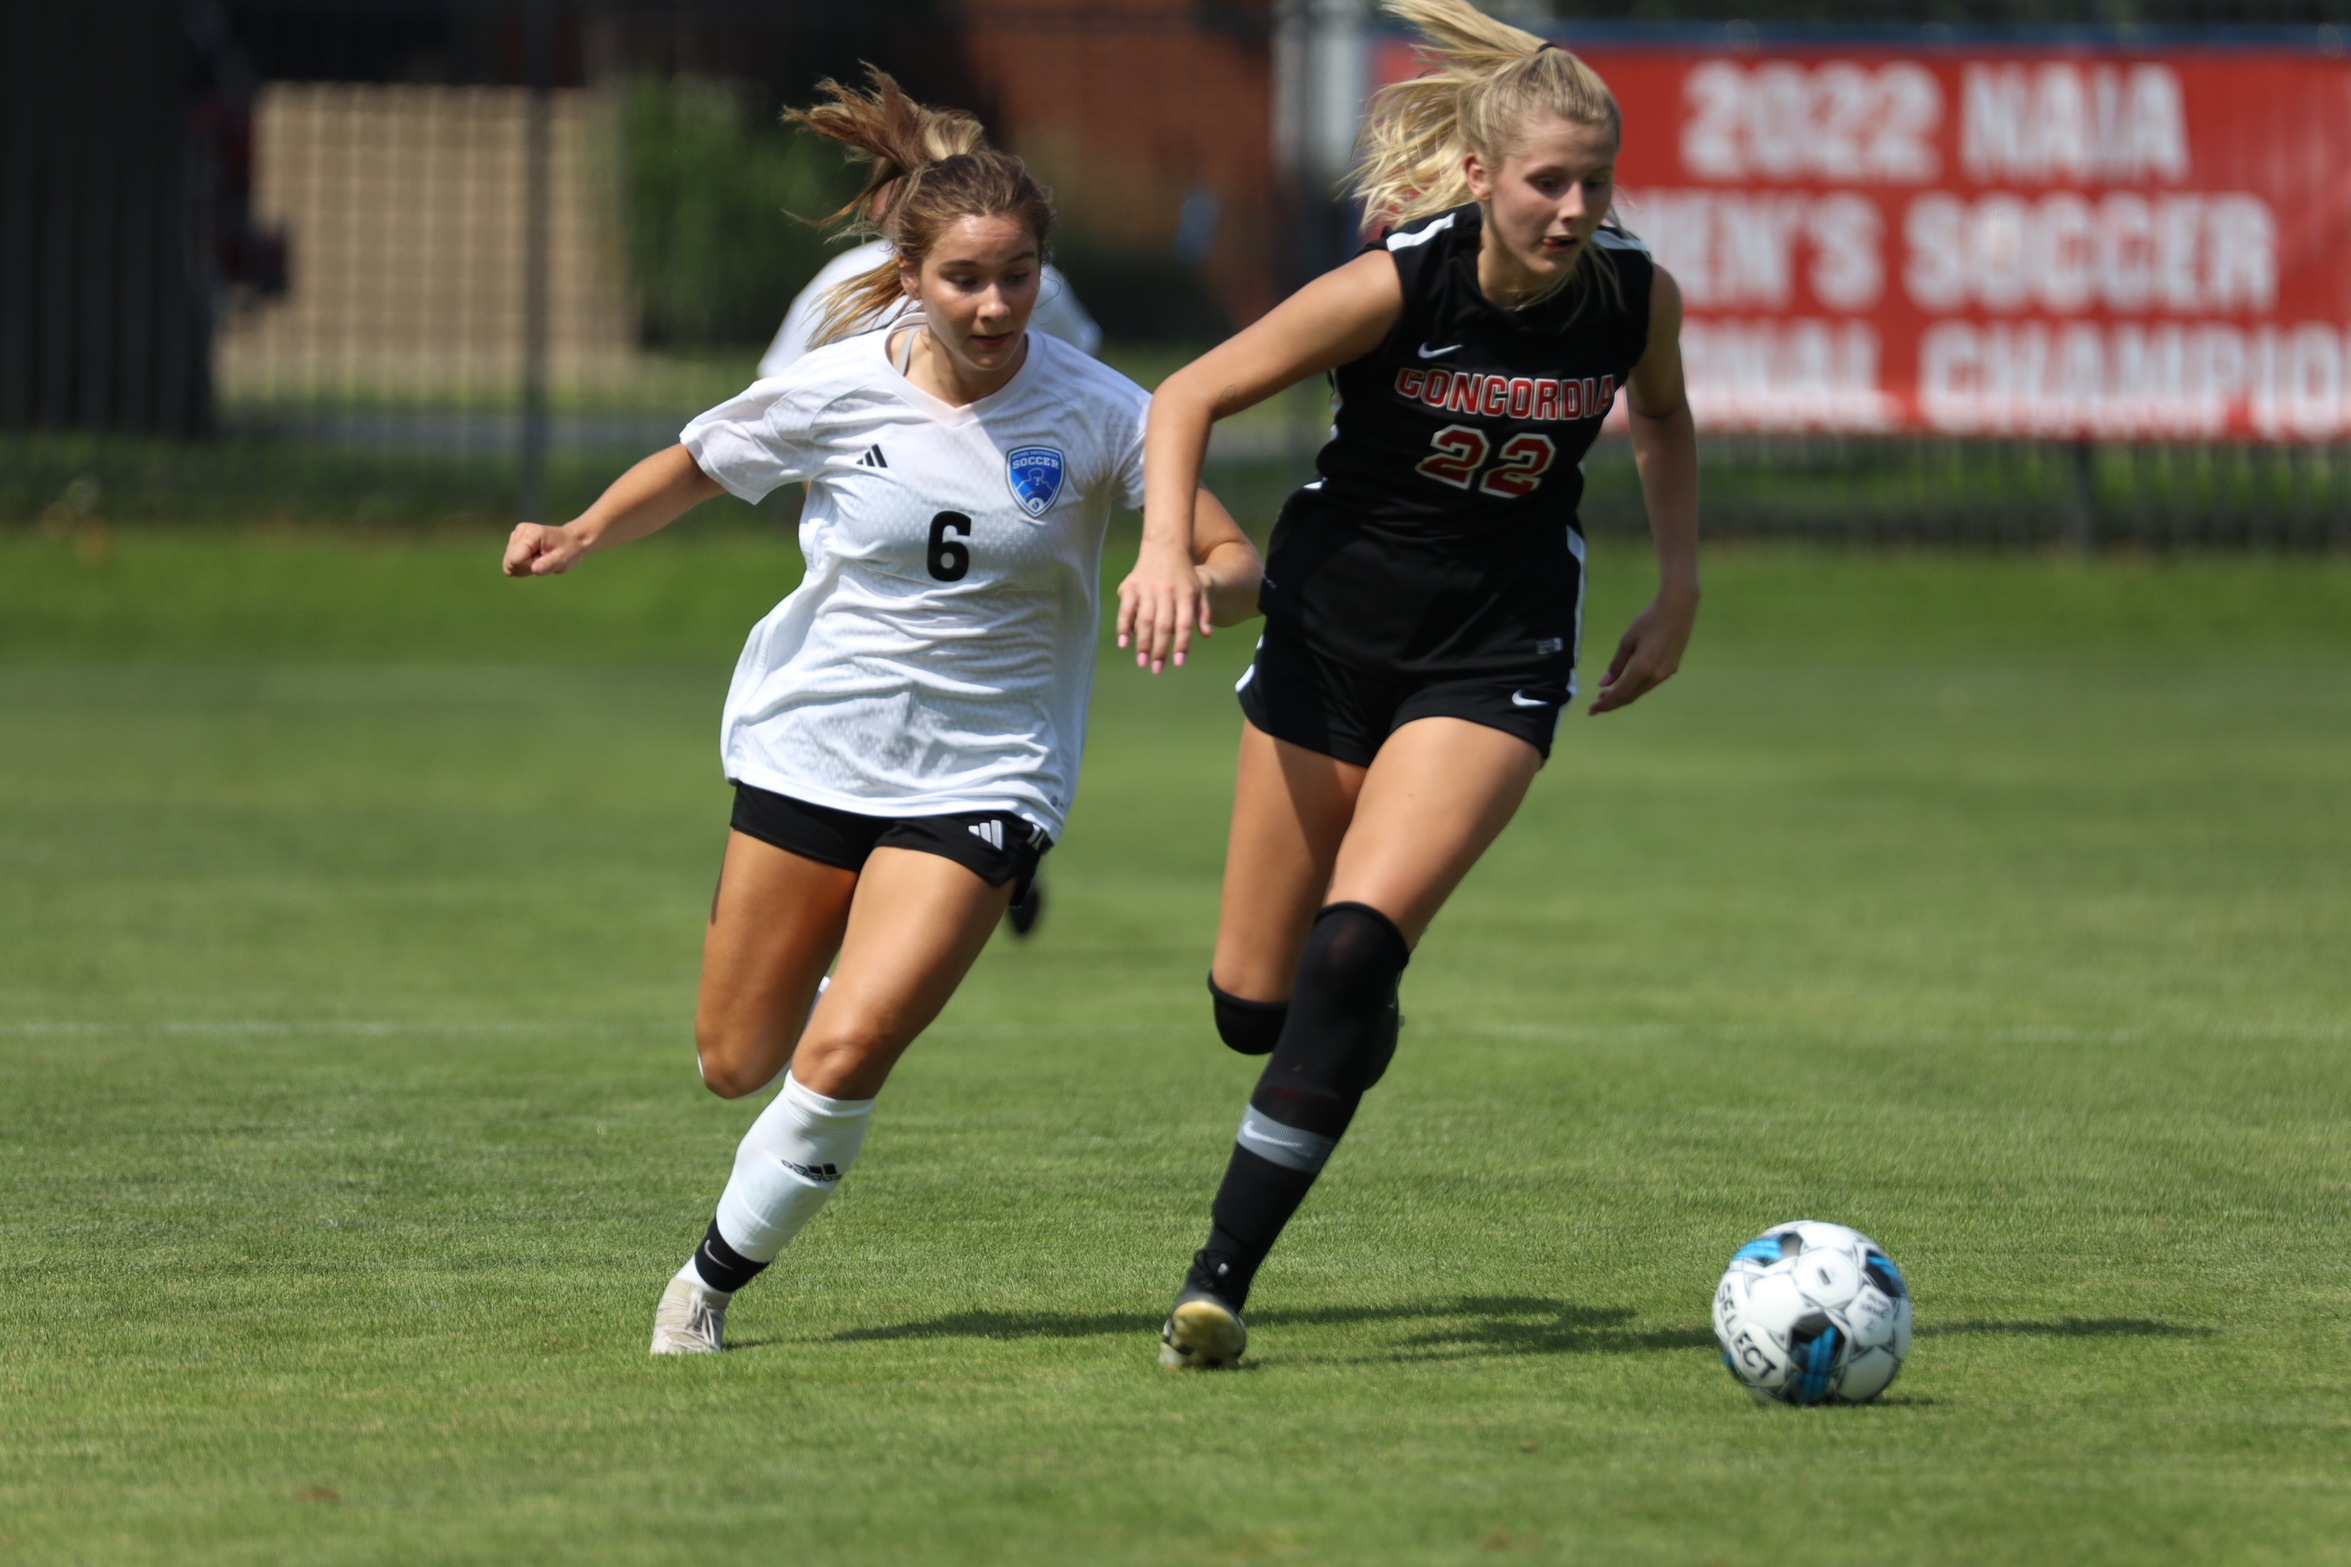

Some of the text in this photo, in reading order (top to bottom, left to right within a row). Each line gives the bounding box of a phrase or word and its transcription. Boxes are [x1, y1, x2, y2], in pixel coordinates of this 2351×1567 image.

[1681, 60, 2189, 182] 2022 NAIA
[1903, 193, 2277, 313] SOCCER
[1394, 367, 1615, 420] CONCORDIA
[1919, 320, 2351, 440] CHAMPIO
[1012, 456, 1060, 470] SOCCER
[1414, 424, 1556, 498] 22
[926, 510, 972, 582] 6
